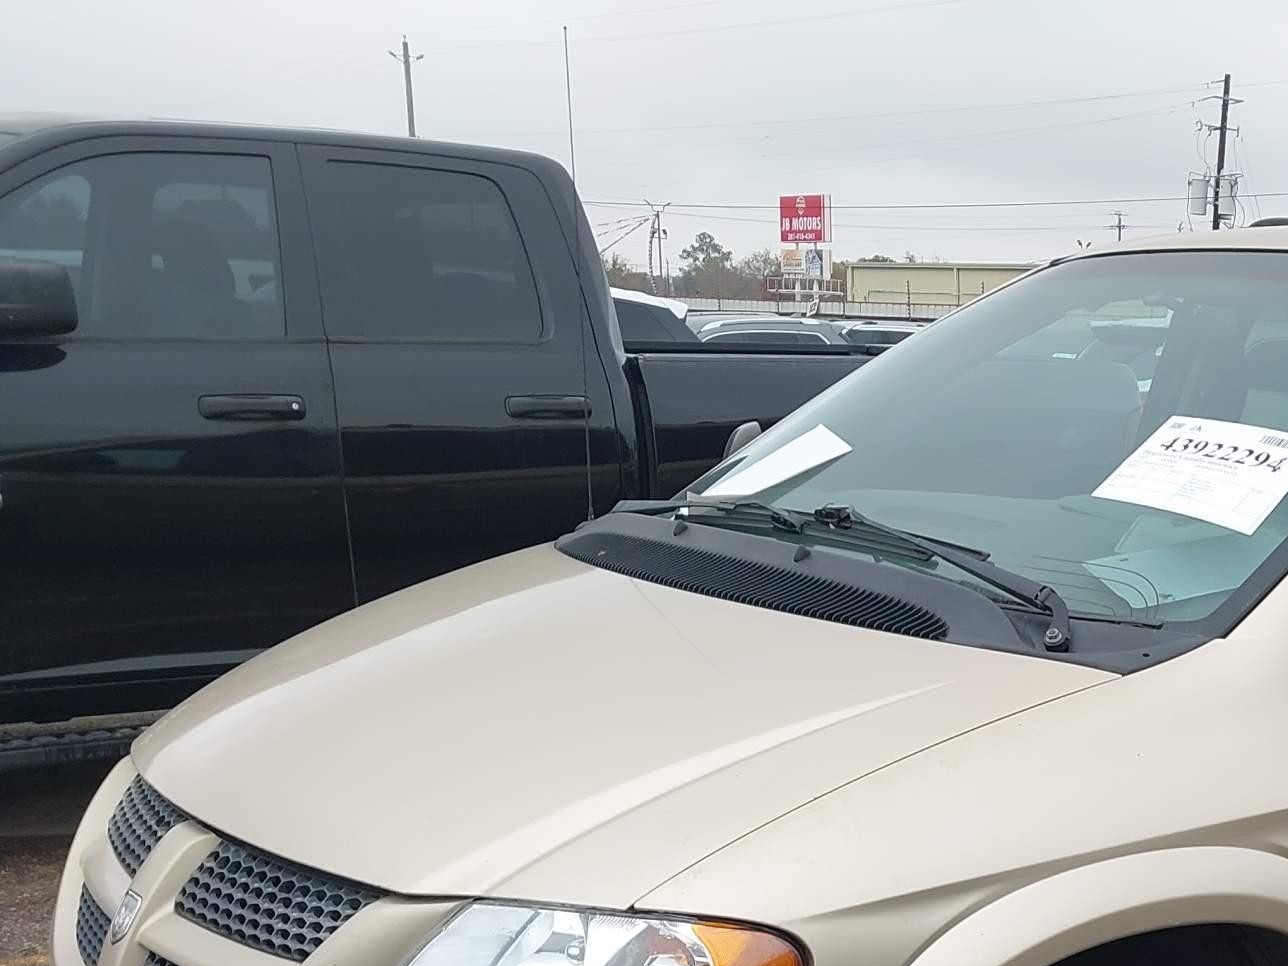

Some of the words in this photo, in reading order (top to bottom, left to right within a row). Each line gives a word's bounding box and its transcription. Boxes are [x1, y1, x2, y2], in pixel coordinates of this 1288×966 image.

[782, 217, 790, 231] JB
[791, 216, 821, 231] MOTORS
[1160, 436, 1288, 473] 43922294
